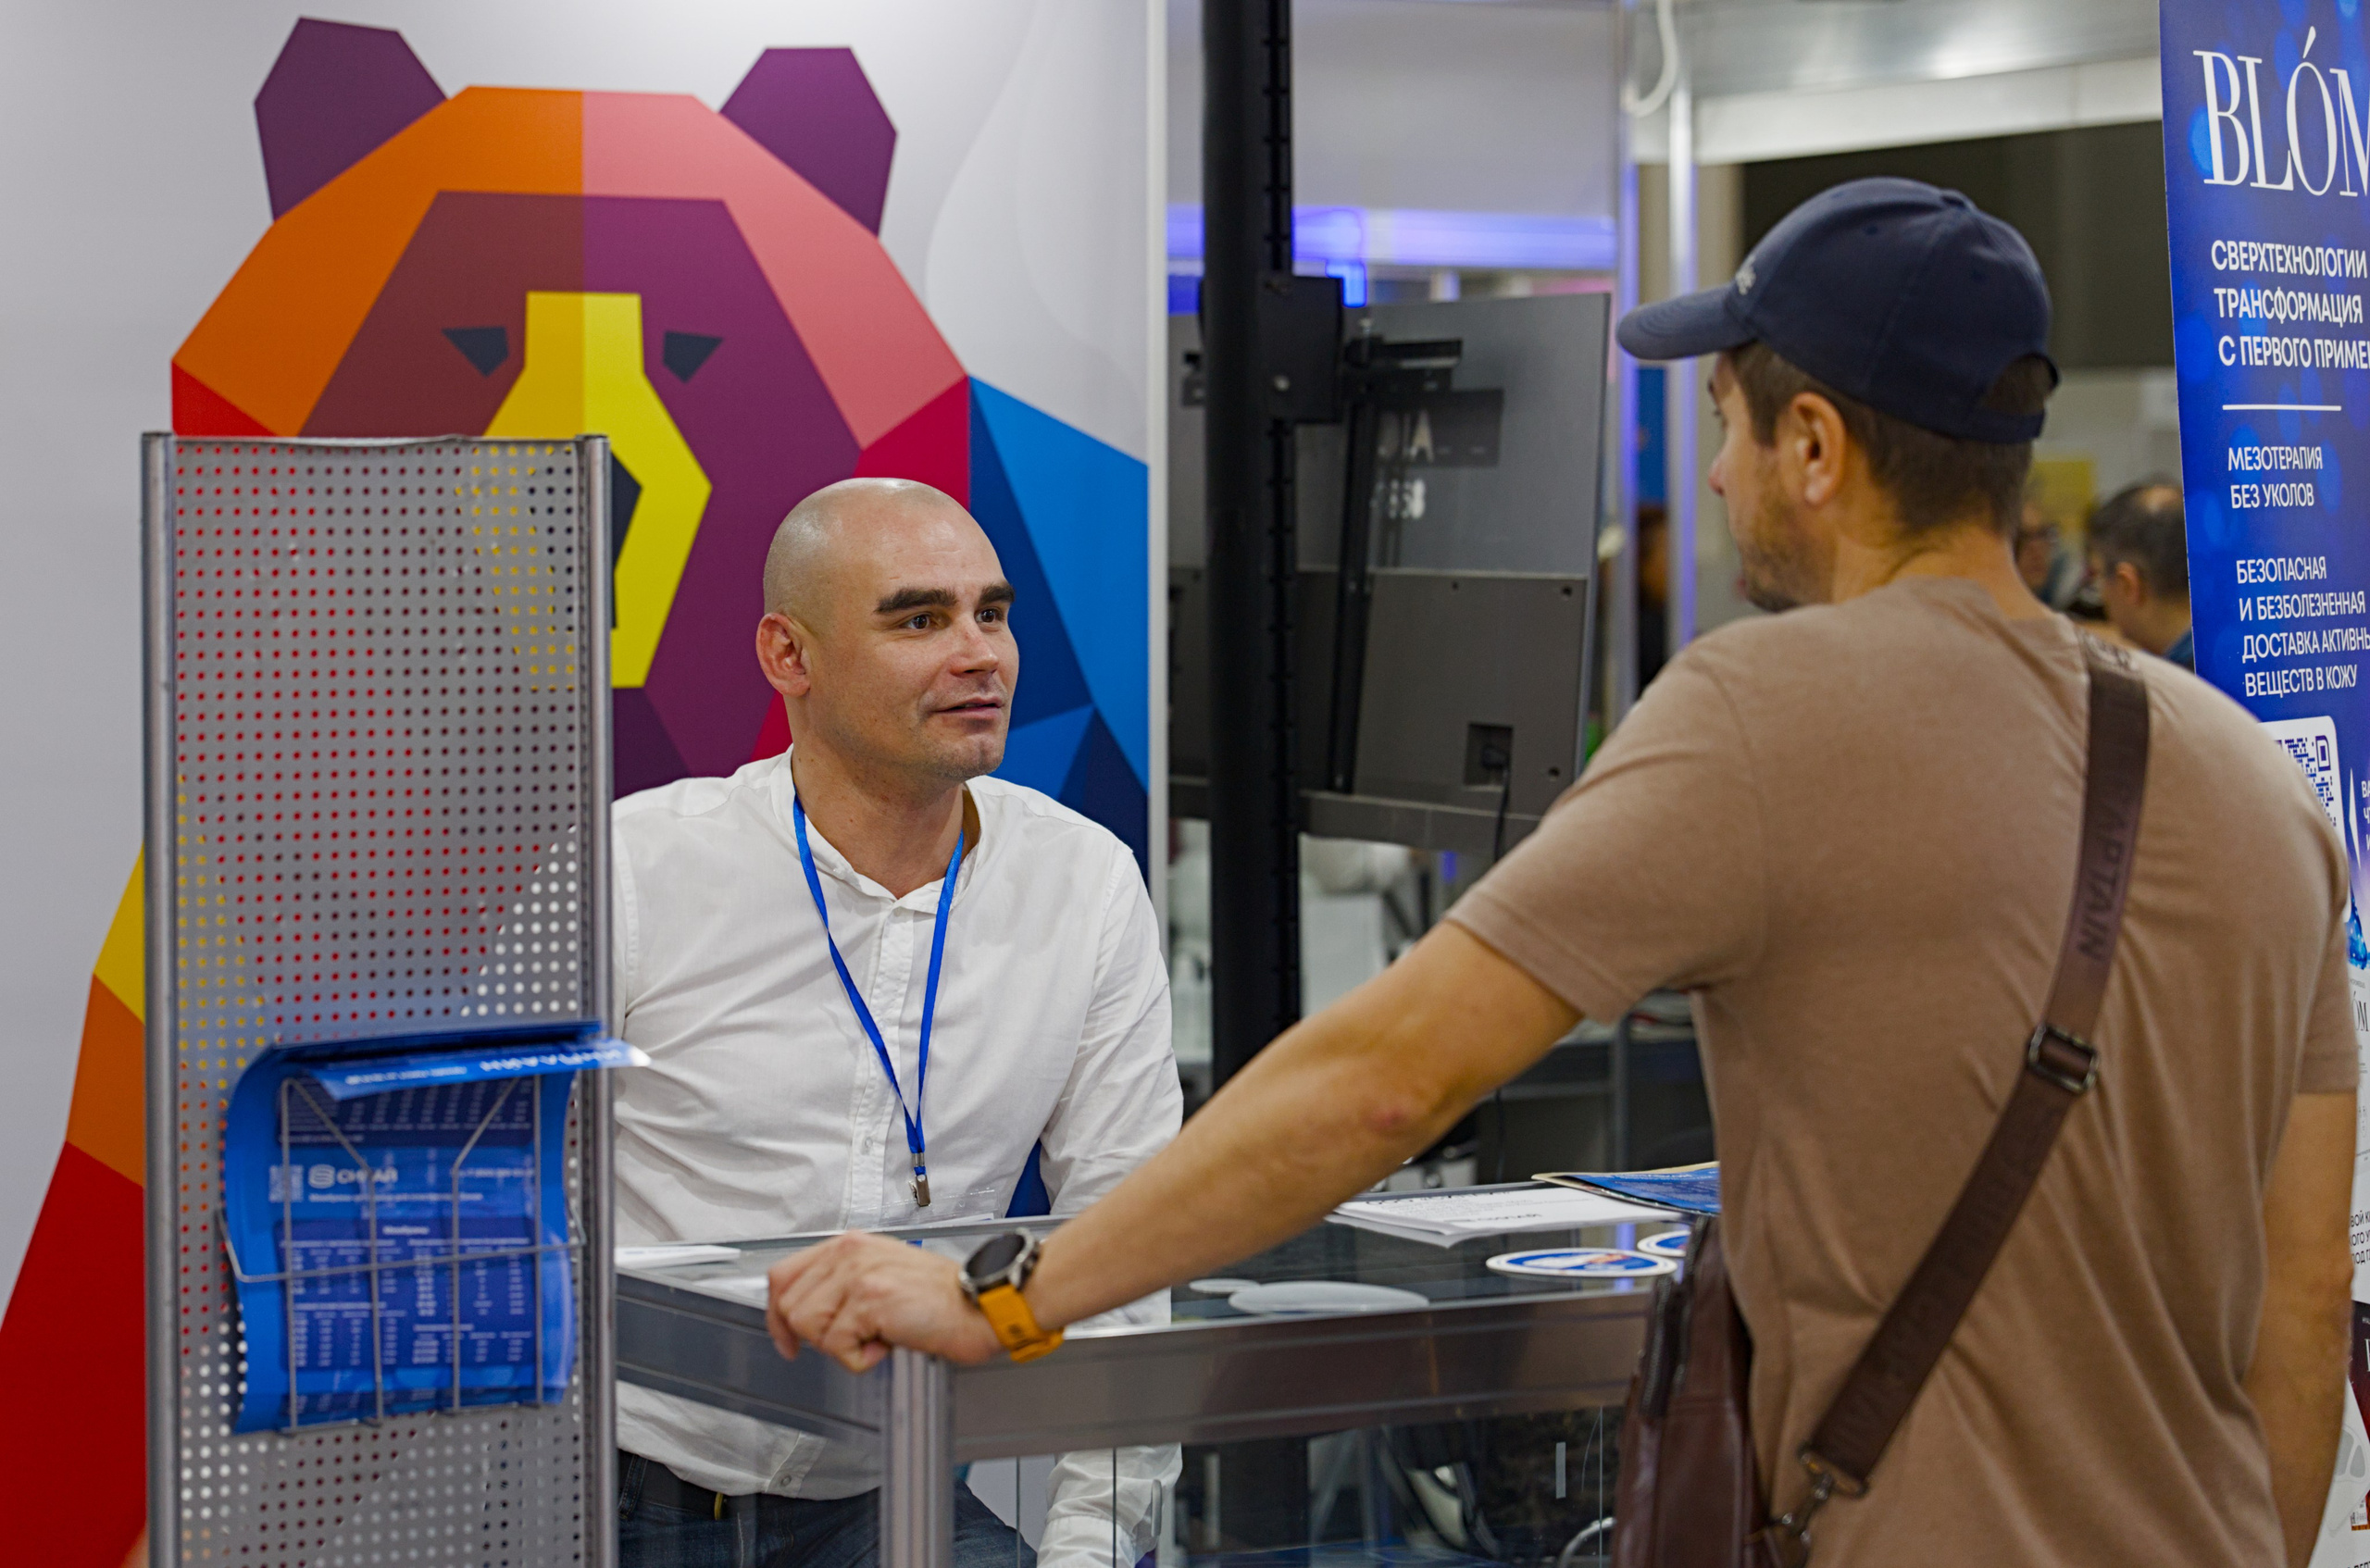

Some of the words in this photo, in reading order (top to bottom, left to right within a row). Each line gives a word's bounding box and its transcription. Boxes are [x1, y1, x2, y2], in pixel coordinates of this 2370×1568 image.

[2211, 239, 2368, 279] СВЕРХТЕХНОЛОГИИ
[2214, 286, 2364, 328] ТРАНСФОРМАЦИЯ
[2218, 335, 2236, 367] С
[2239, 335, 2313, 367] ПЕРВОГО
[2314, 338, 2370, 369] ПРИМЕ
[2227, 446, 2323, 471] МЕЗОТЕРАПИЯ
[2230, 483, 2260, 509] БЕЗ
[2262, 482, 2314, 507] УКОЛОВ
[2236, 556, 2326, 584] БЕЗОПАСНАЯ
[2239, 597, 2252, 621] И
[2256, 591, 2366, 620] БЕЗБОЛЕЗНЕННАЯ
[2242, 630, 2320, 664] ДОСТАВКА
[2244, 667, 2314, 698] ВЕЩЕСТВ
[2315, 666, 2325, 691] В
[2325, 664, 2357, 690] КОЖУ
[2077, 792, 2127, 962] APTAIN
